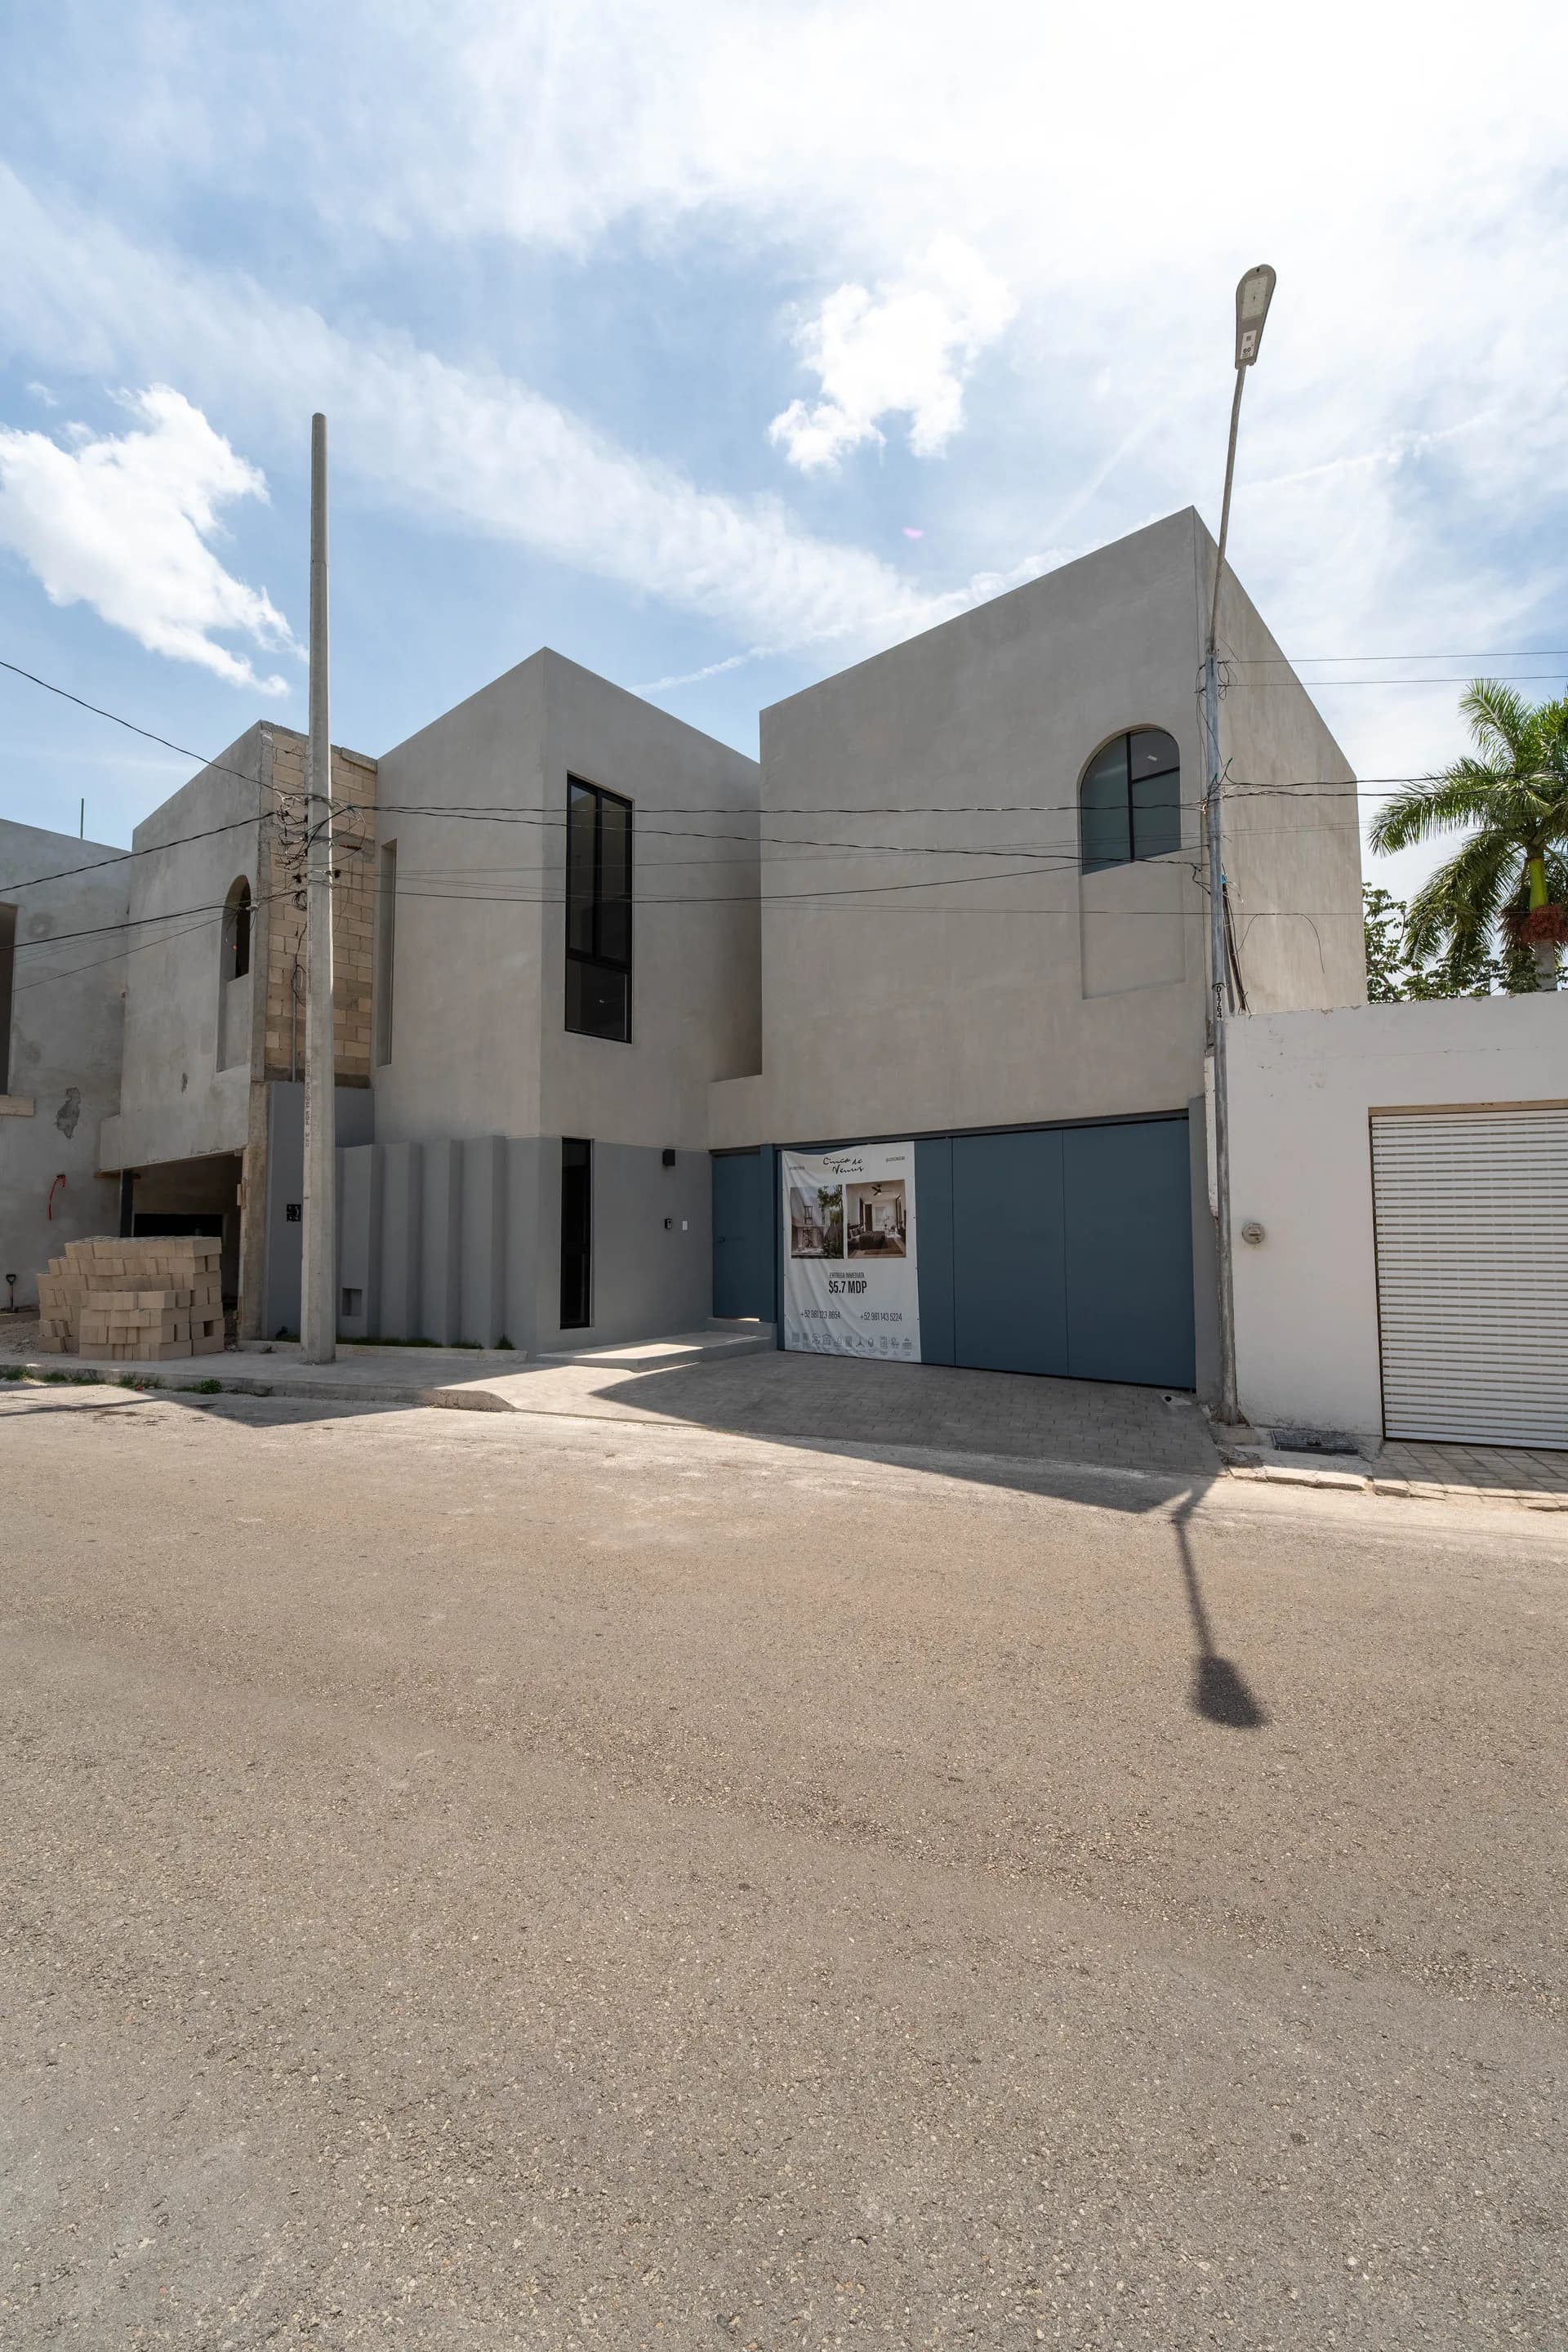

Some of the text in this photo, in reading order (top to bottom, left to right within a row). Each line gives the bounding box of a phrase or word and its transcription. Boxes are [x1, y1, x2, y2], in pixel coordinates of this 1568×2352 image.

[832, 1164, 864, 1175] Venus
[828, 1280, 867, 1294] $5.7 MDP
[800, 1309, 810, 1318] +52
[861, 1312, 871, 1321] +52
[889, 1312, 902, 1322] 5224
